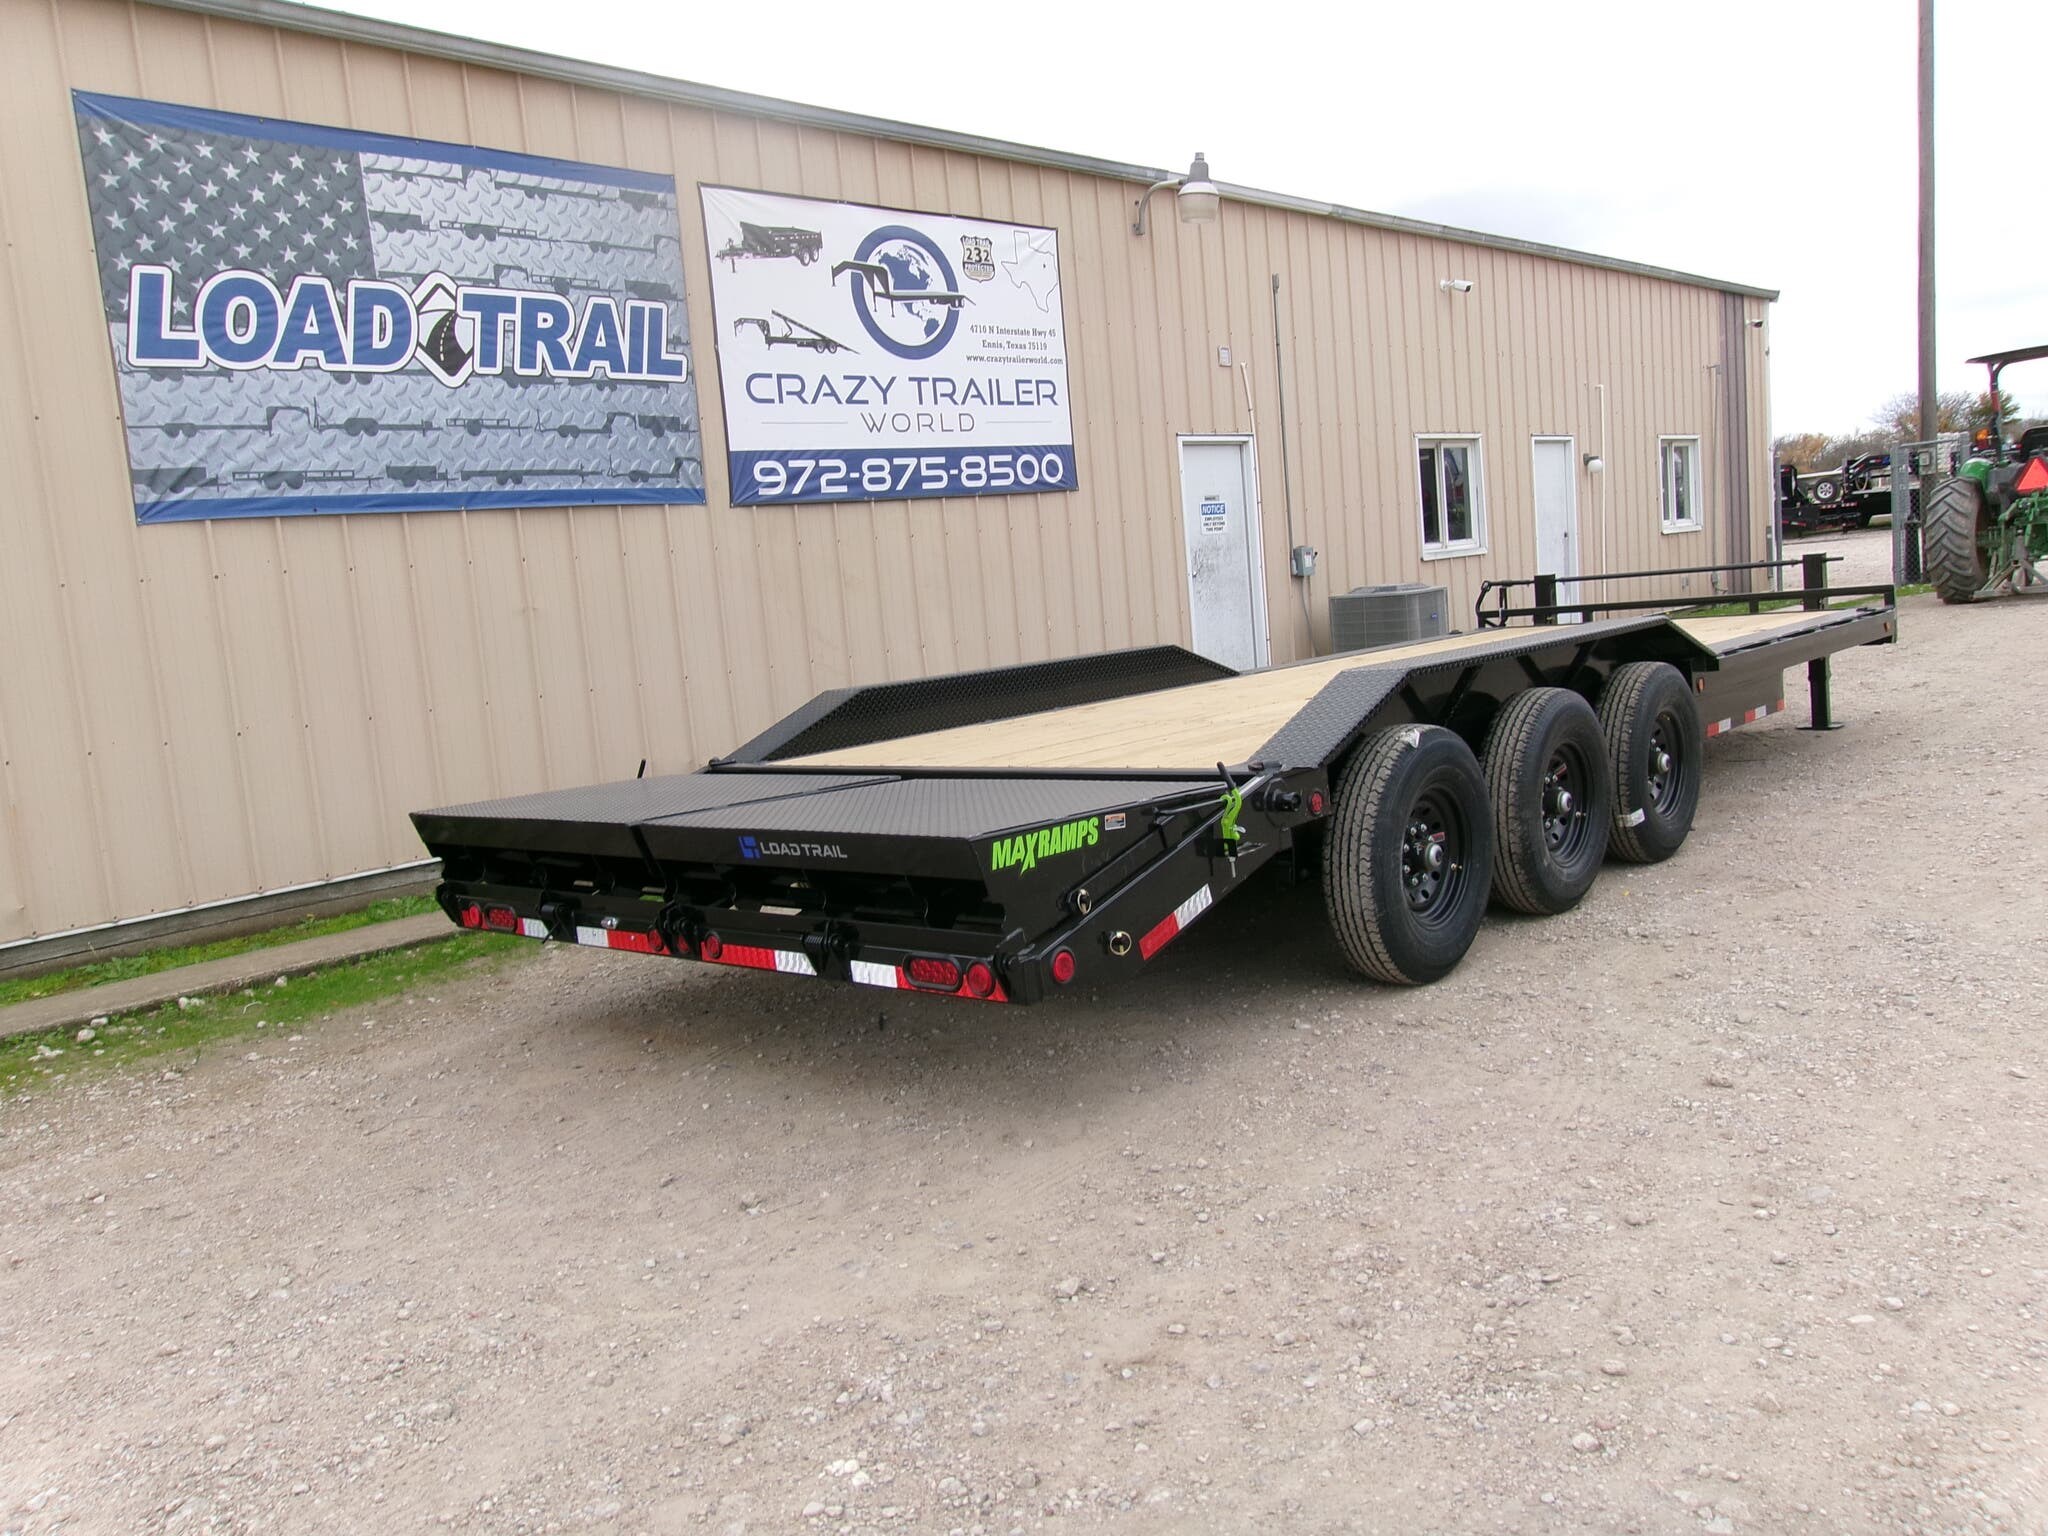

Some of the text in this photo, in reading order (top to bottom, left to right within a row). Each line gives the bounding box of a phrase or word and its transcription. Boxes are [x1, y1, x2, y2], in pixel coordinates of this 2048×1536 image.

[966, 247, 990, 263] 232
[129, 264, 689, 383] LOAD TRAIL
[970, 323, 1056, 339] 4710 N Interstate Hwy 45
[982, 339, 1048, 351] Ennis, Texas 75119
[966, 354, 1064, 365] www.crazytrailerworld.com
[745, 372, 1059, 407] CRAZY TRAILER
[860, 412, 976, 433] WORLD
[753, 453, 1064, 496] 972-875-8500
[1202, 504, 1225, 515] NOTICE
[991, 817, 1099, 876] MAXRAMPS
